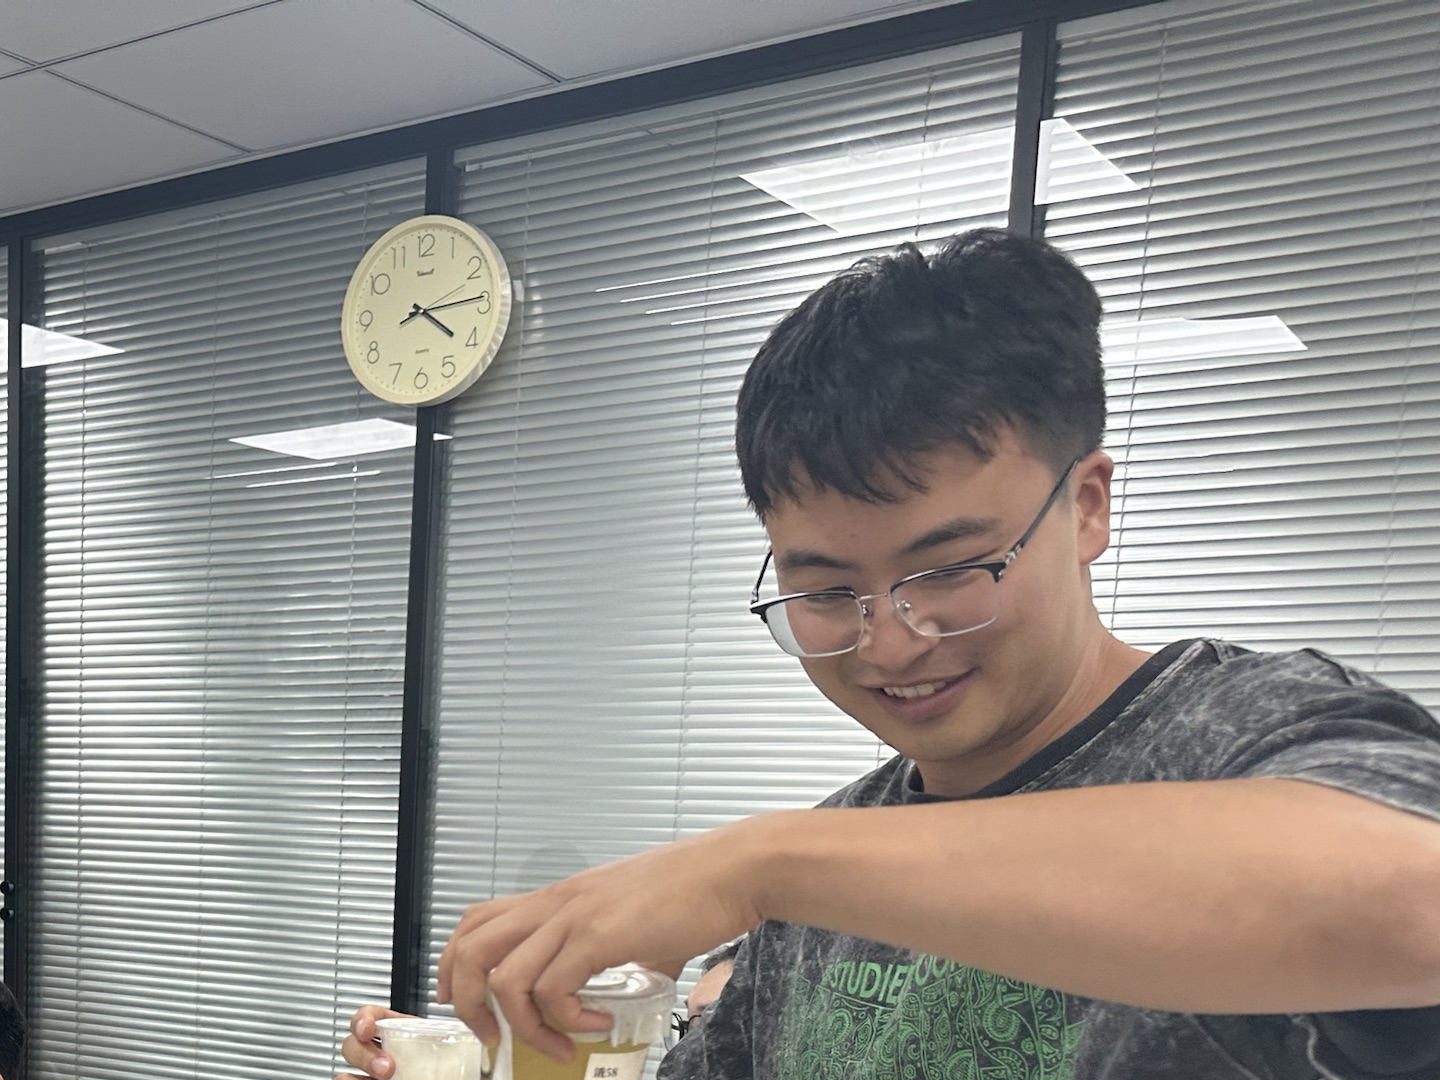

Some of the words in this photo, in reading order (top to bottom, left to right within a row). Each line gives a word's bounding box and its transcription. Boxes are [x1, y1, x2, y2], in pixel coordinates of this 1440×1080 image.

[418, 234, 436, 258] 12
[390, 246, 406, 270] 11
[467, 256, 482, 280] 2
[370, 273, 391, 296] 10
[477, 290, 491, 314] 3
[360, 310, 374, 332] 9
[466, 326, 478, 349] 4
[366, 341, 380, 364] 8
[389, 362, 402, 385] 7
[414, 366, 428, 390] 6
[440, 356, 456, 378] 5
